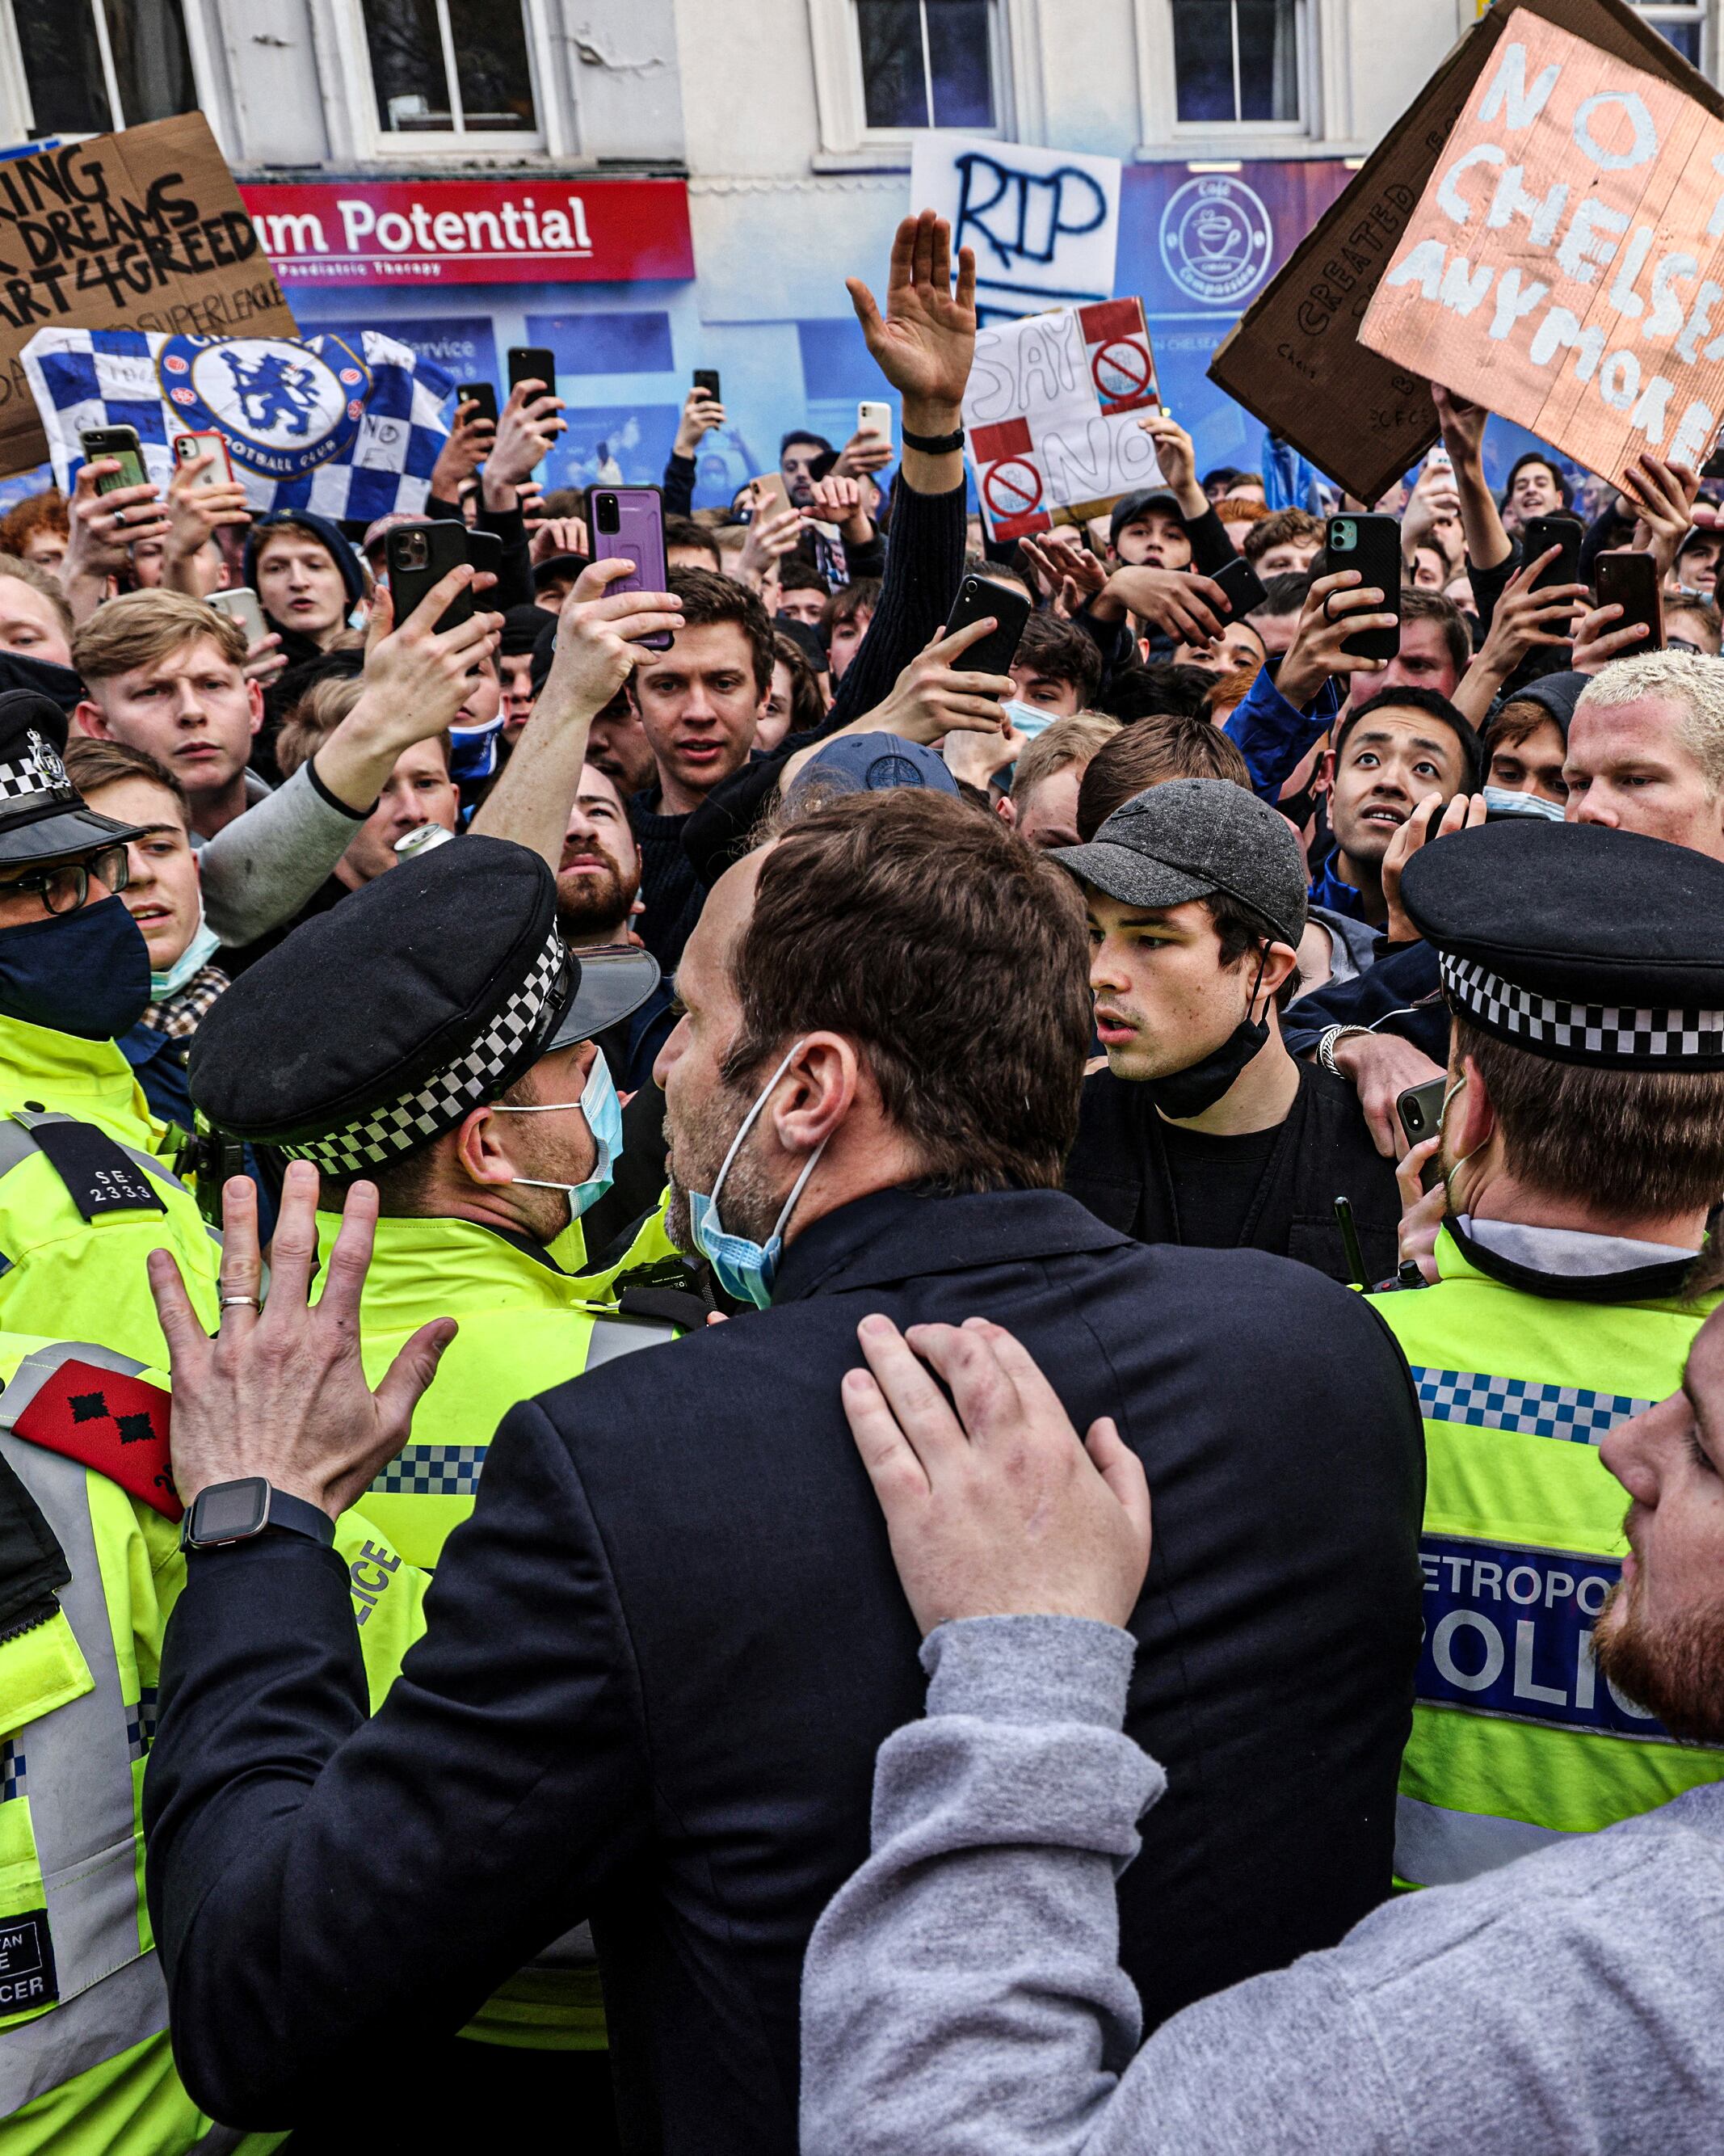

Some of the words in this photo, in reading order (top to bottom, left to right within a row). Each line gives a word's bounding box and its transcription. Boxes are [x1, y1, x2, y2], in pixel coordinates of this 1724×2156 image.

[1478, 42, 1659, 171] NO
[0, 144, 108, 221] ING
[16, 173, 199, 267] DREAMS
[337, 196, 592, 253] Potential
[954, 151, 1107, 270] RIP
[277, 262, 367, 277] Paediatric
[372, 261, 442, 276] Therapy
[1297, 183, 1417, 336] CREATED
[1435, 144, 1724, 366] CHELSE
[971, 314, 1075, 420] SAY
[1386, 239, 1714, 470] ANYMORE
[208, 425, 294, 472] OTBALL
[1041, 415, 1157, 503] NO
[90, 1185, 151, 1202] 2333
[1421, 1609, 1656, 1720] OLI
[0, 1934, 23, 1950] AN
[0, 1977, 44, 2002] CER
